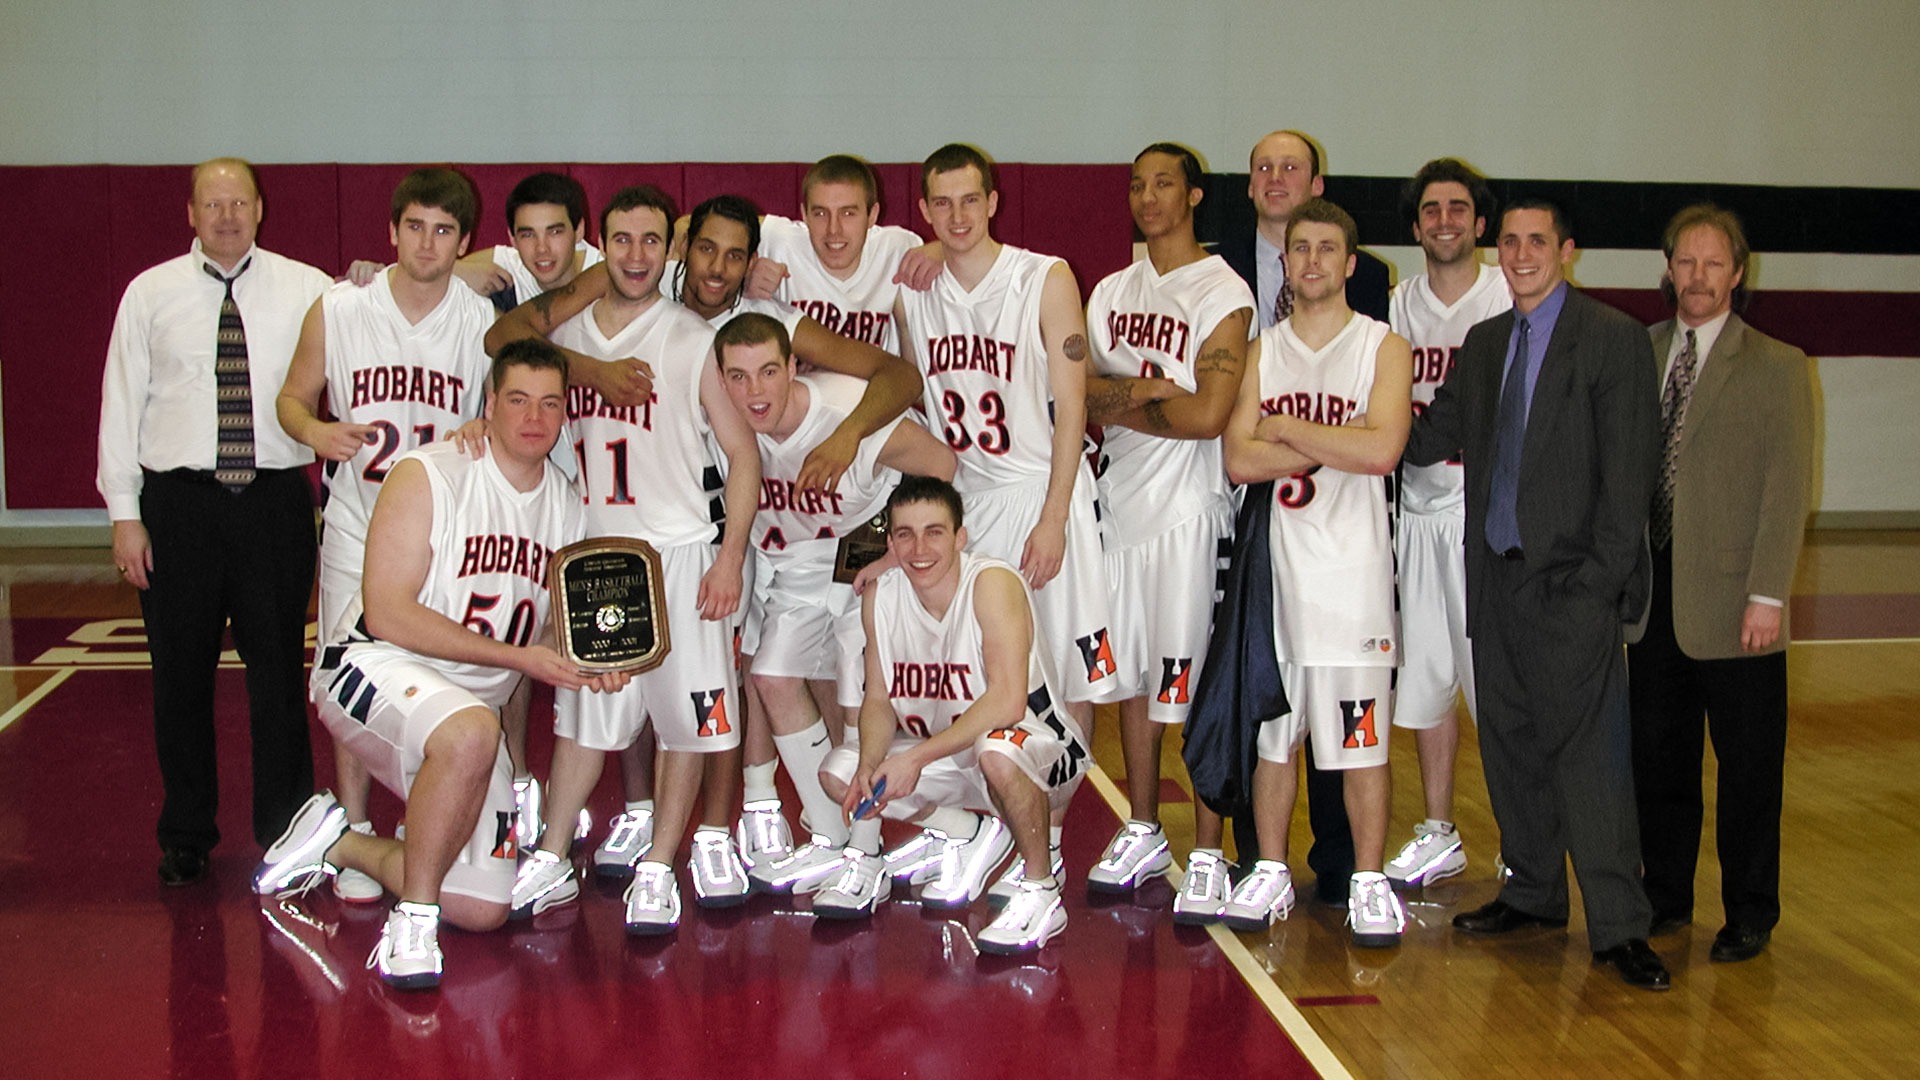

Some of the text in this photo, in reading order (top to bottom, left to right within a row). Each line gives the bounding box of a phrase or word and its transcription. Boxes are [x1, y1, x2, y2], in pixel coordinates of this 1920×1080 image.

[790, 299, 890, 347] OBART
[350, 365, 464, 416] HOBART
[566, 384, 658, 433] OBT
[942, 389, 1011, 456] 33
[757, 477, 844, 516] OBRT
[457, 533, 555, 591] HOBART
